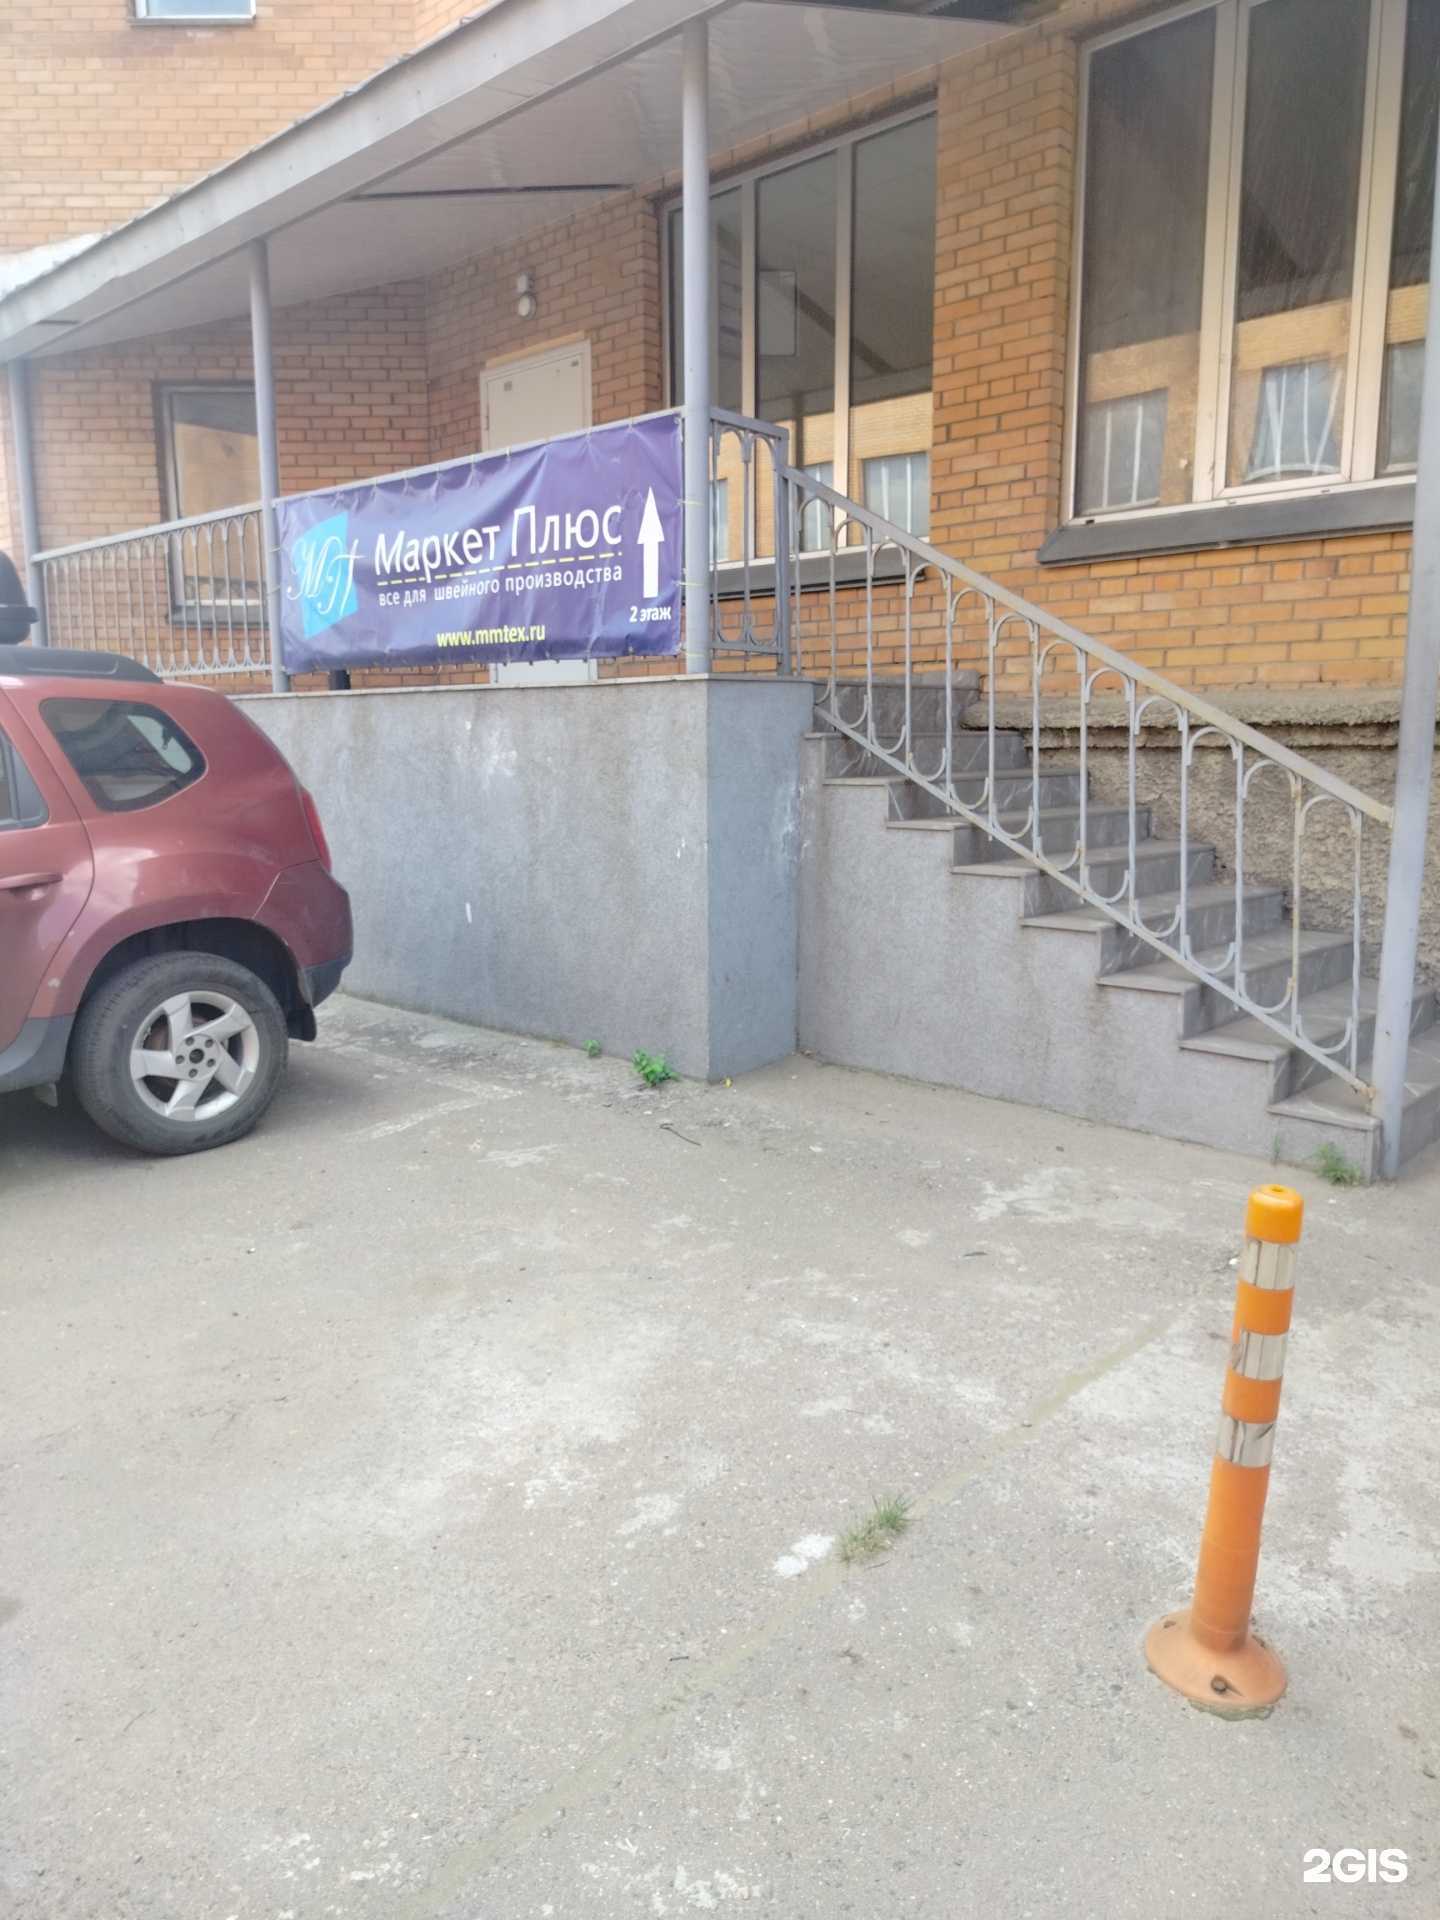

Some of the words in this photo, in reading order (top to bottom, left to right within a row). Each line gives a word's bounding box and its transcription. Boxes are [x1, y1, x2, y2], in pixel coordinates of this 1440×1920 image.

[374, 524, 500, 583] Маркет
[378, 592, 400, 607] все
[403, 590, 427, 607] для
[434, 578, 500, 602] швейного
[505, 565, 622, 594] производства
[629, 606, 638, 622] 2
[640, 605, 672, 621] этаж
[436, 624, 546, 648] www.mmtex.ru
